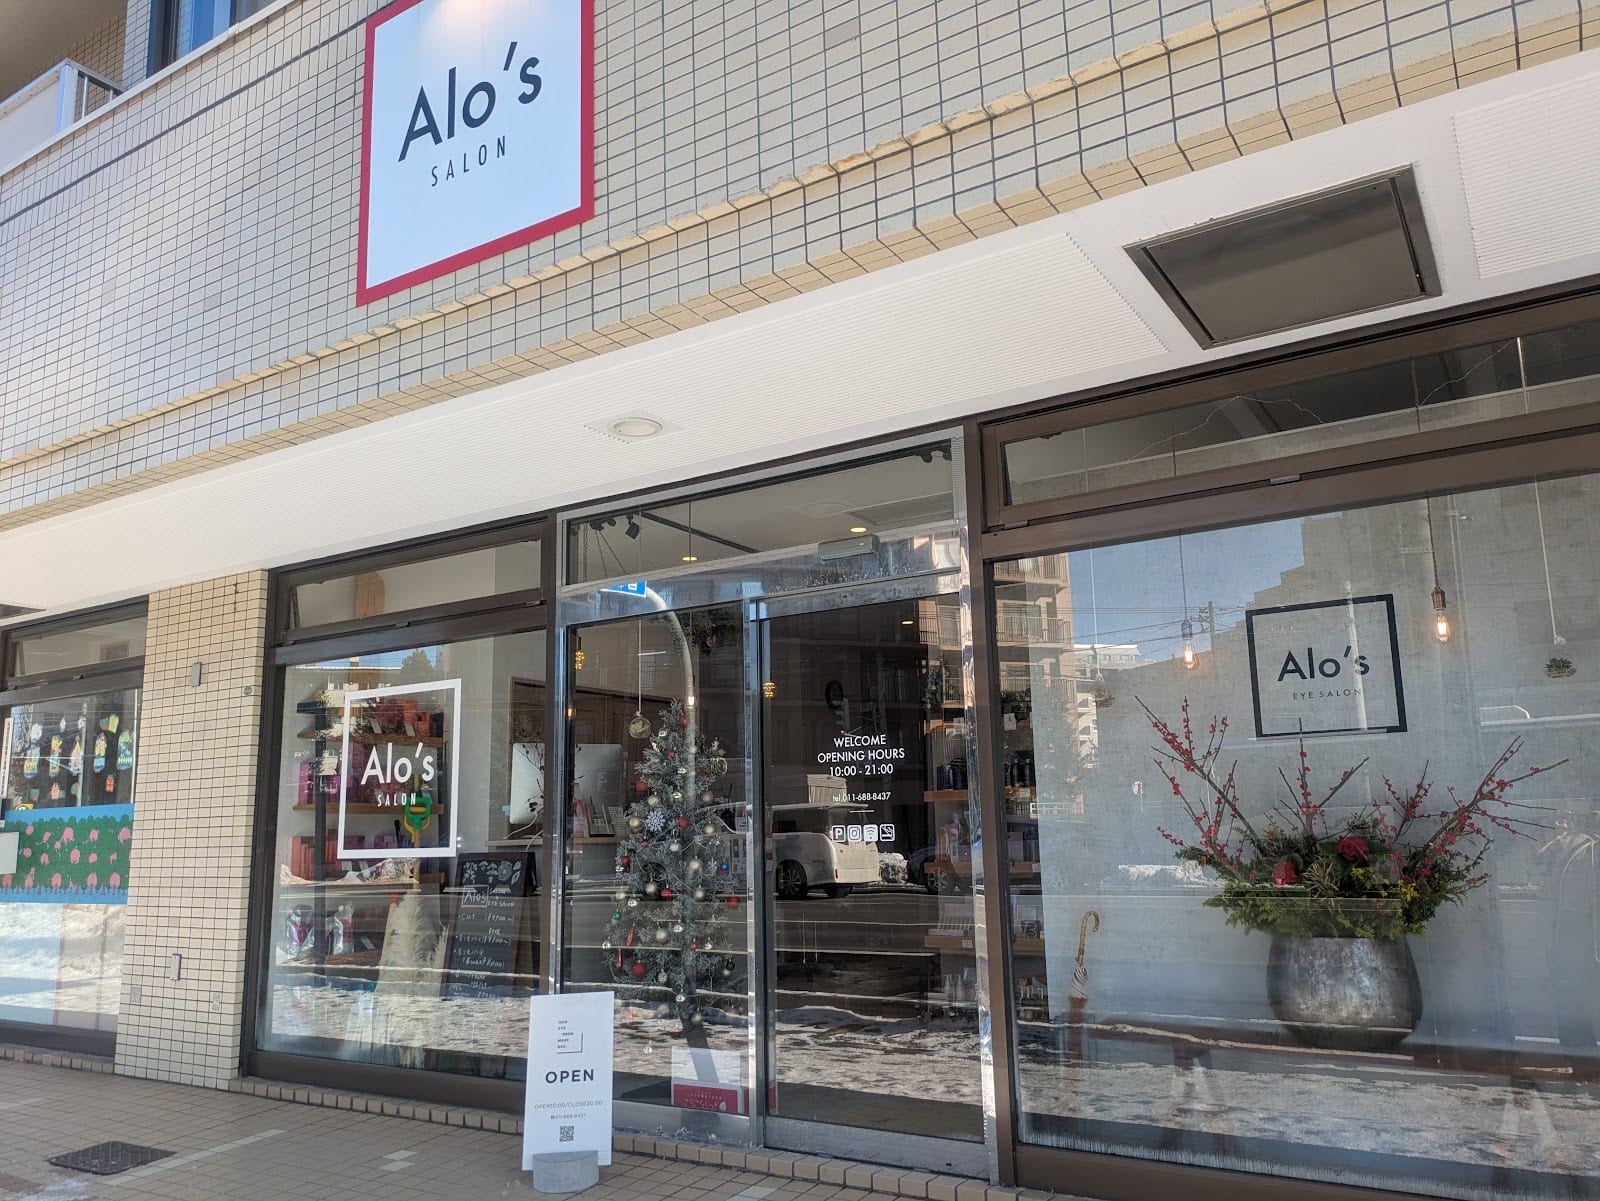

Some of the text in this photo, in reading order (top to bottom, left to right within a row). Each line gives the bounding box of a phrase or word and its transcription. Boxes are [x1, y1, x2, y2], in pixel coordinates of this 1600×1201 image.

[398, 41, 542, 162] Alo's
[431, 136, 506, 187] SALON
[1277, 645, 1370, 681] Alo's
[1293, 688, 1362, 700] EYE SALON
[833, 734, 887, 748] WELCOME
[817, 748, 905, 763] OPENING HOURS
[361, 742, 435, 785] Alo's
[829, 765, 857, 777] 10:00
[864, 763, 894, 775] 21:00
[377, 792, 416, 807] SALON
[545, 1068, 594, 1084] OPEN
